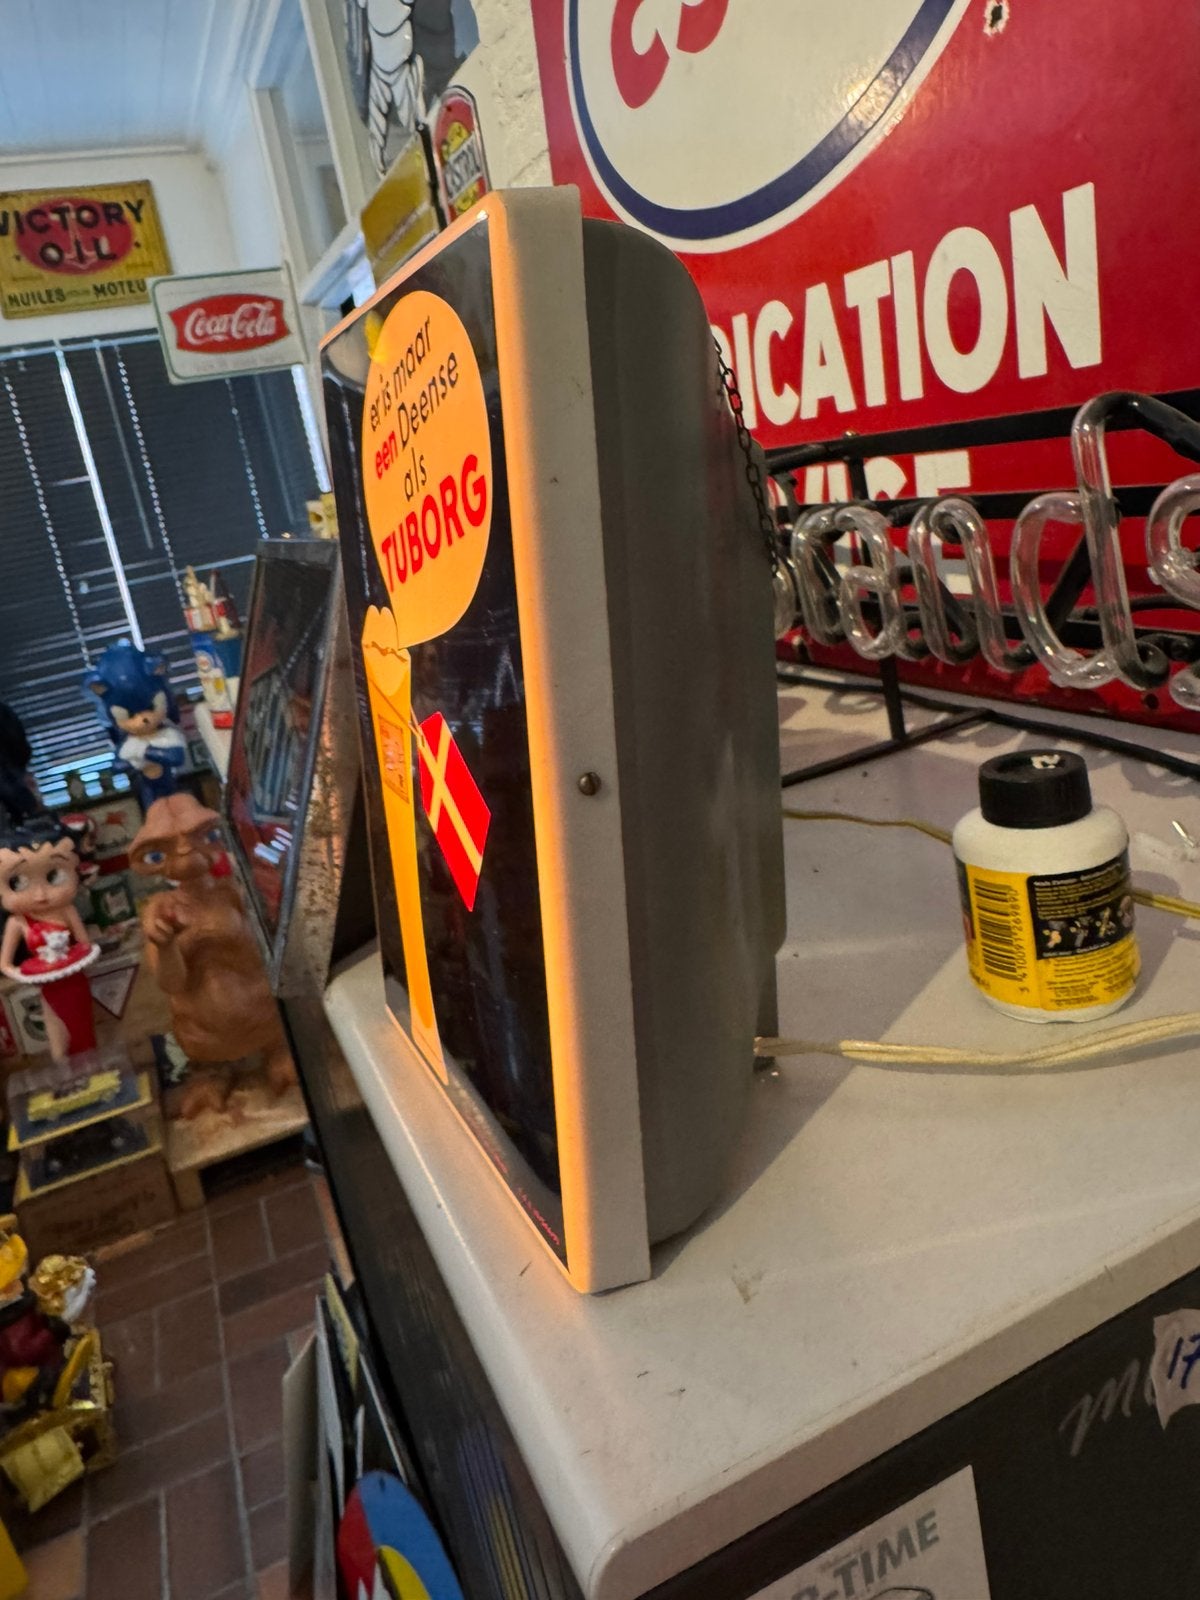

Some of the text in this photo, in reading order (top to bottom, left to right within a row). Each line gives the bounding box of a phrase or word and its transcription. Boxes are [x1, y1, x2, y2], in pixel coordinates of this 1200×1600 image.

[40, 239, 116, 267] OIL
[393, 316, 431, 400] maar
[375, 352, 459, 480] een Deense
[404, 447, 428, 502] als
[381, 454, 487, 593] TUBORG
